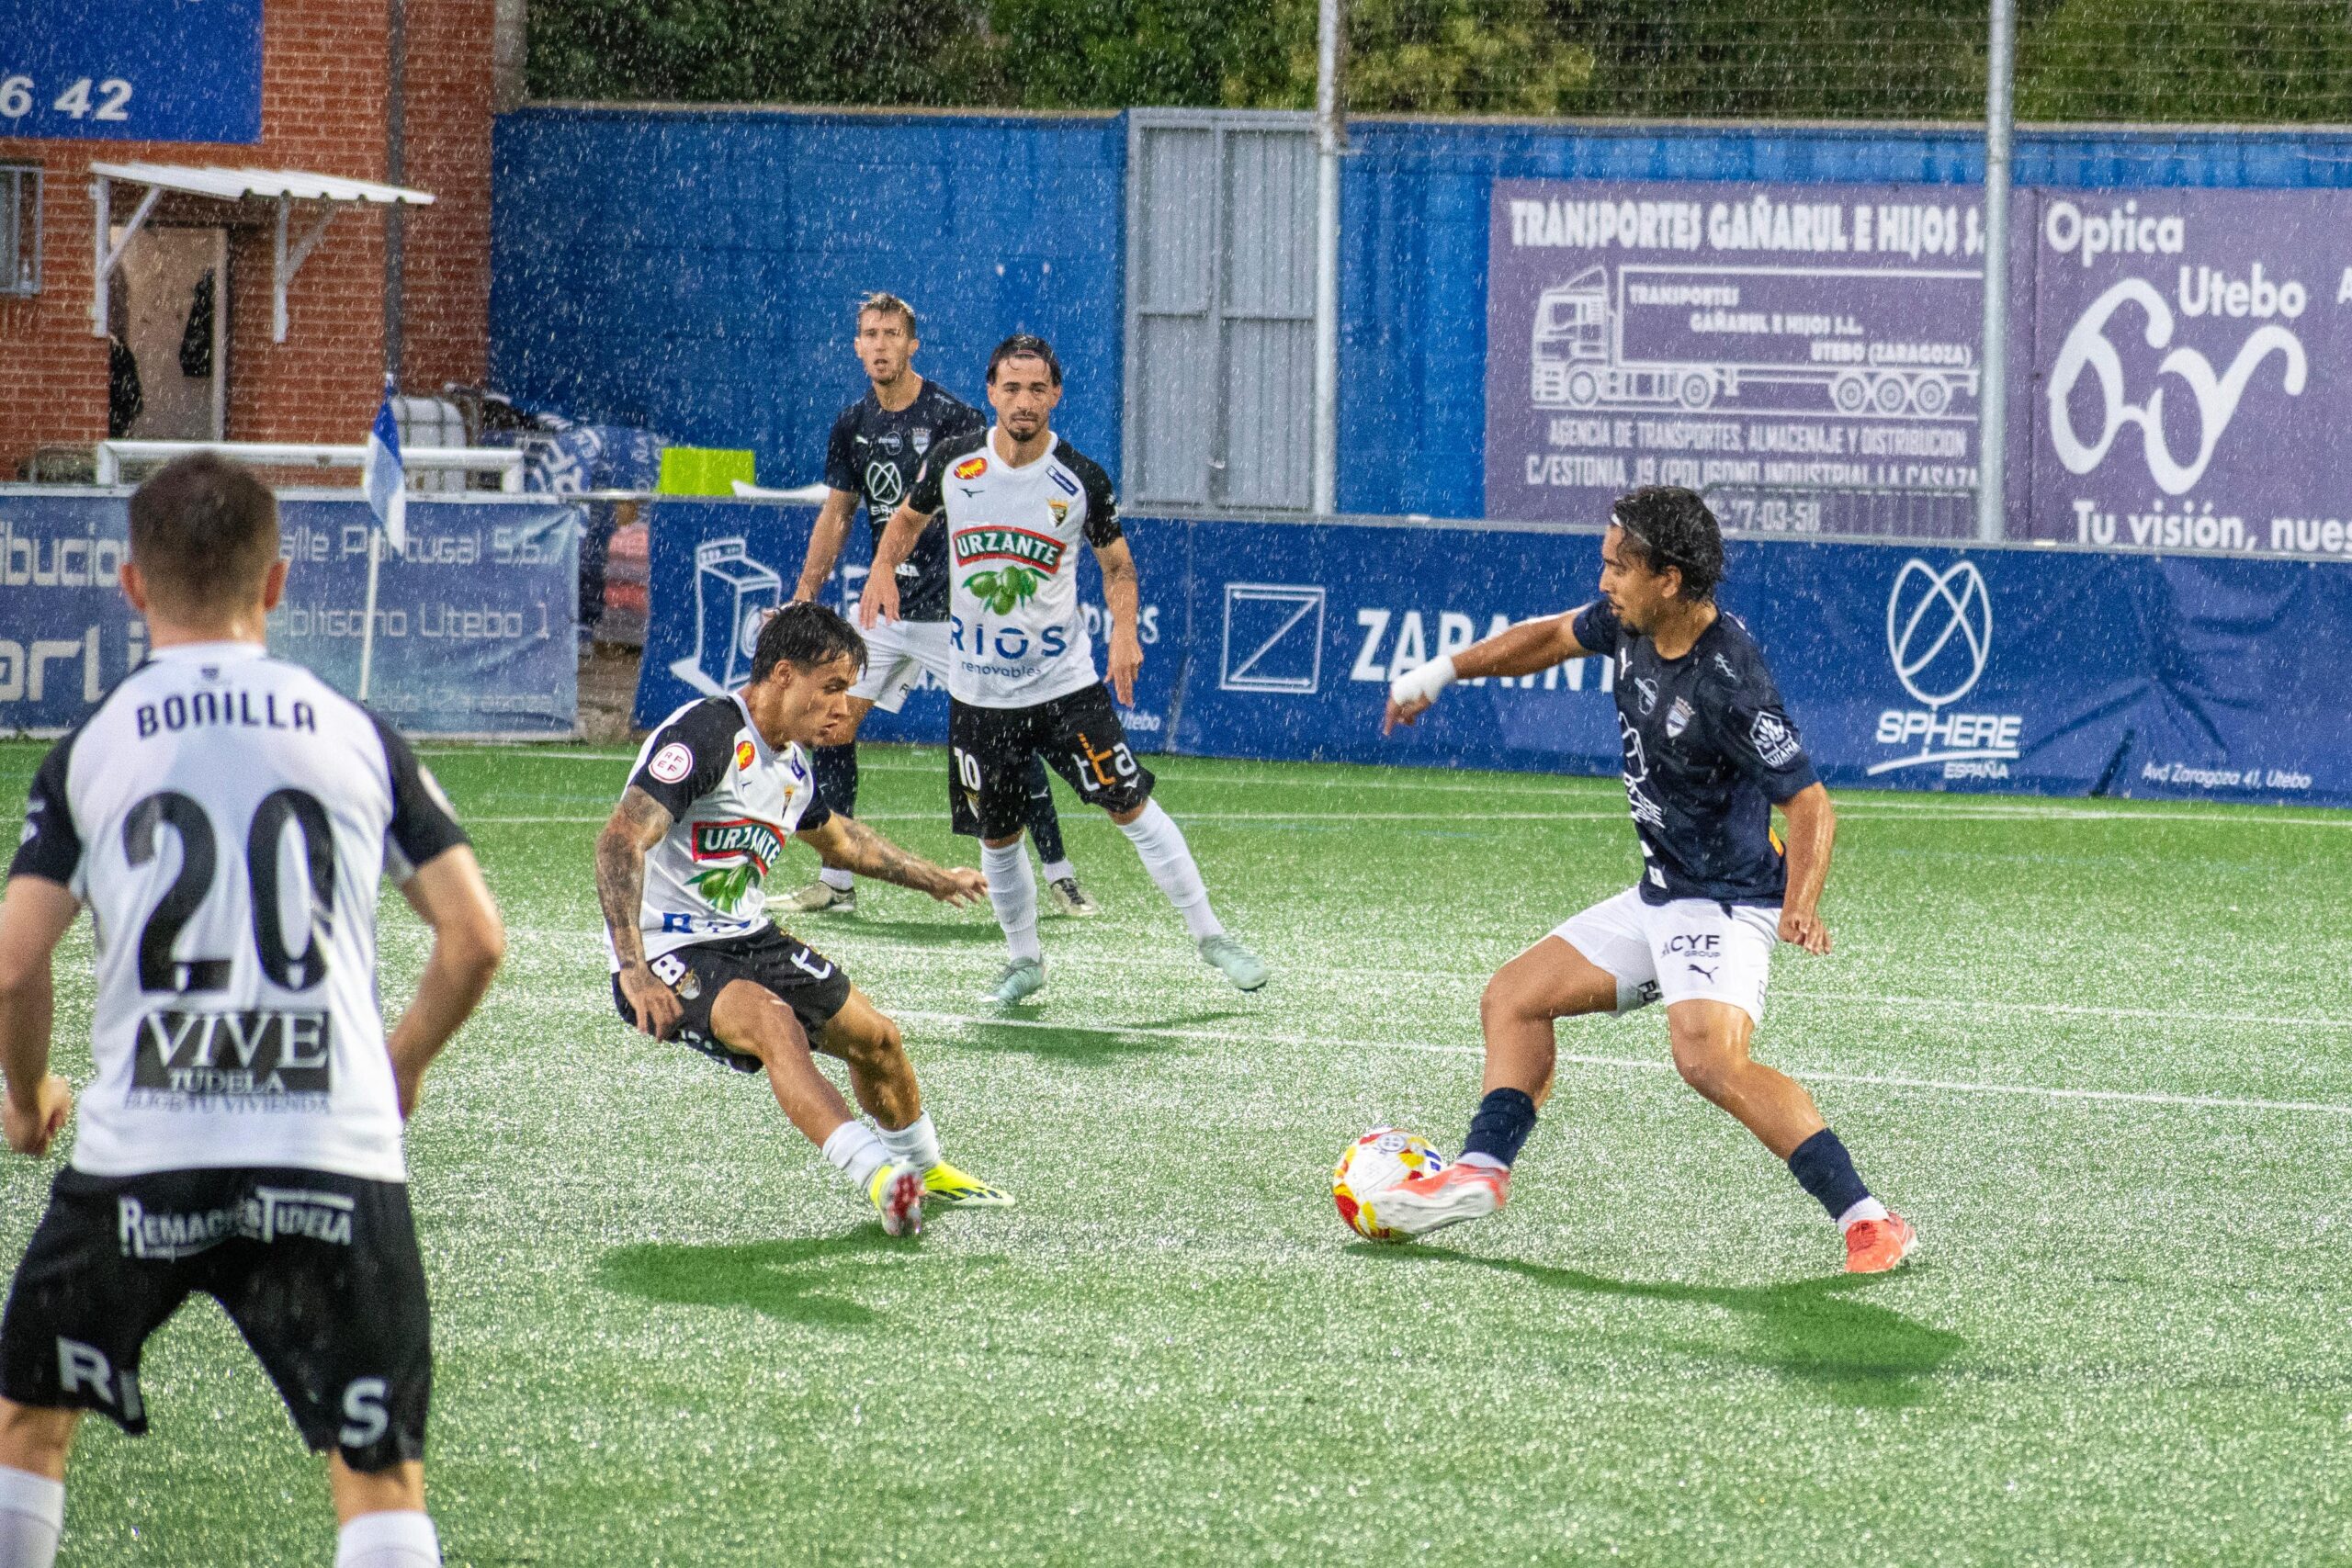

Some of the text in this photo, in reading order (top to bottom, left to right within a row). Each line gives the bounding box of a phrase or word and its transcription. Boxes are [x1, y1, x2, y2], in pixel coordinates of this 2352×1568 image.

[53, 77, 133, 121] 42
[1511, 200, 1702, 251] TRANSPORTES
[1710, 195, 1847, 253] GAÑARUL
[1854, 205, 1872, 253] E
[1877, 205, 1958, 261] HIJOS
[2046, 199, 2186, 267] Optica
[1629, 285, 1740, 307] TRANSPORTES
[2178, 262, 2307, 318] Utebo
[1690, 309, 1769, 333] GAÑARUL
[1772, 313, 1782, 334] E
[1786, 313, 1831, 336] HIJOS
[1811, 341, 1973, 367] UTEBO (ZARAGOZA)
[1549, 420, 1609, 446] AGENCIA
[1614, 421, 1634, 447] DE
[1748, 423, 1844, 454] ALMACENAJE
[1847, 426, 1860, 455] Y
[278, 525, 330, 562] alle
[2073, 500, 2116, 545] Tu
[2127, 499, 2257, 551] visión,
[956, 532, 1060, 566] URZANTE
[420, 601, 524, 638] Utebo
[137, 690, 315, 741] BONILLA
[1876, 709, 2022, 749] SPHERE
[954, 747, 981, 792] 10
[1943, 761, 2008, 779] ESPAÑA
[2142, 761, 2170, 781] Avd
[2171, 763, 2241, 789] Zaragoza
[2266, 769, 2312, 790] Utebo
[705, 827, 780, 868] URZANTE
[122, 788, 336, 992] 20
[651, 953, 685, 986] 8
[146, 1012, 329, 1069] VIVE
[169, 1067, 286, 1096] TUDELA
